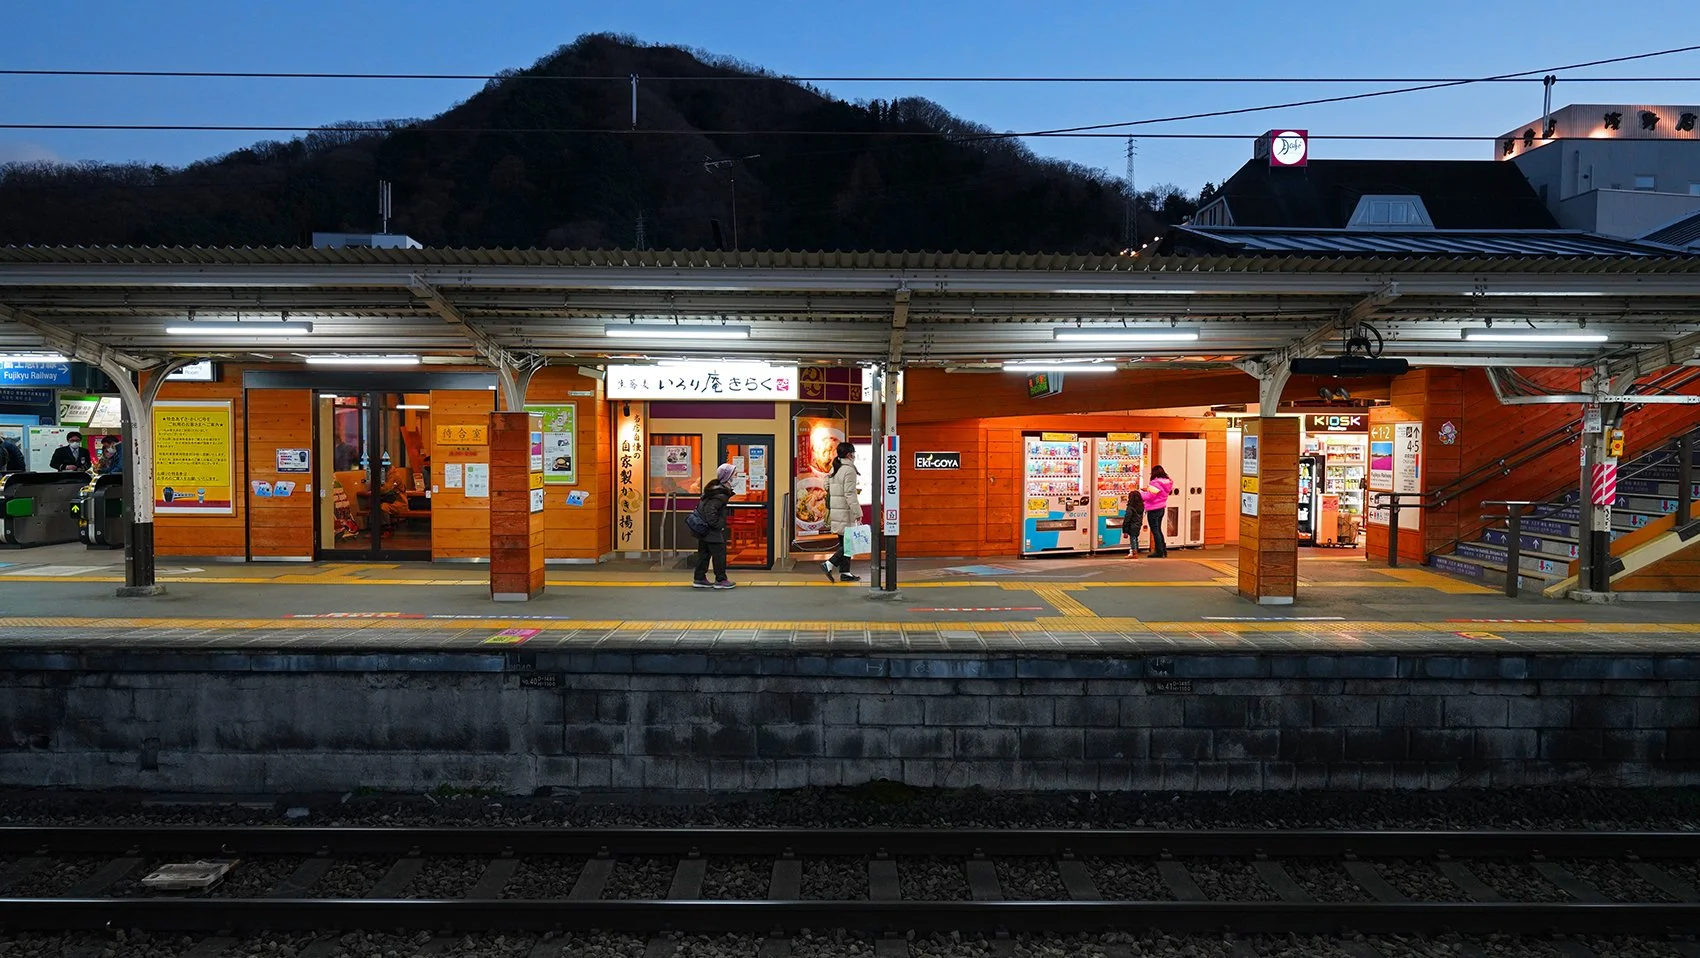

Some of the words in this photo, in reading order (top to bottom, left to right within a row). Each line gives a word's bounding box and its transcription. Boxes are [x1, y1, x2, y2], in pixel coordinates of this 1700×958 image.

[4, 371, 29, 381] Fujikyu
[31, 371, 57, 381] Railway
[1314, 416, 1361, 426] KIOSK
[442, 427, 482, 439] 待合室
[887, 454, 897, 495] おおつき
[619, 439, 634, 543] 自家製かき揚げ
